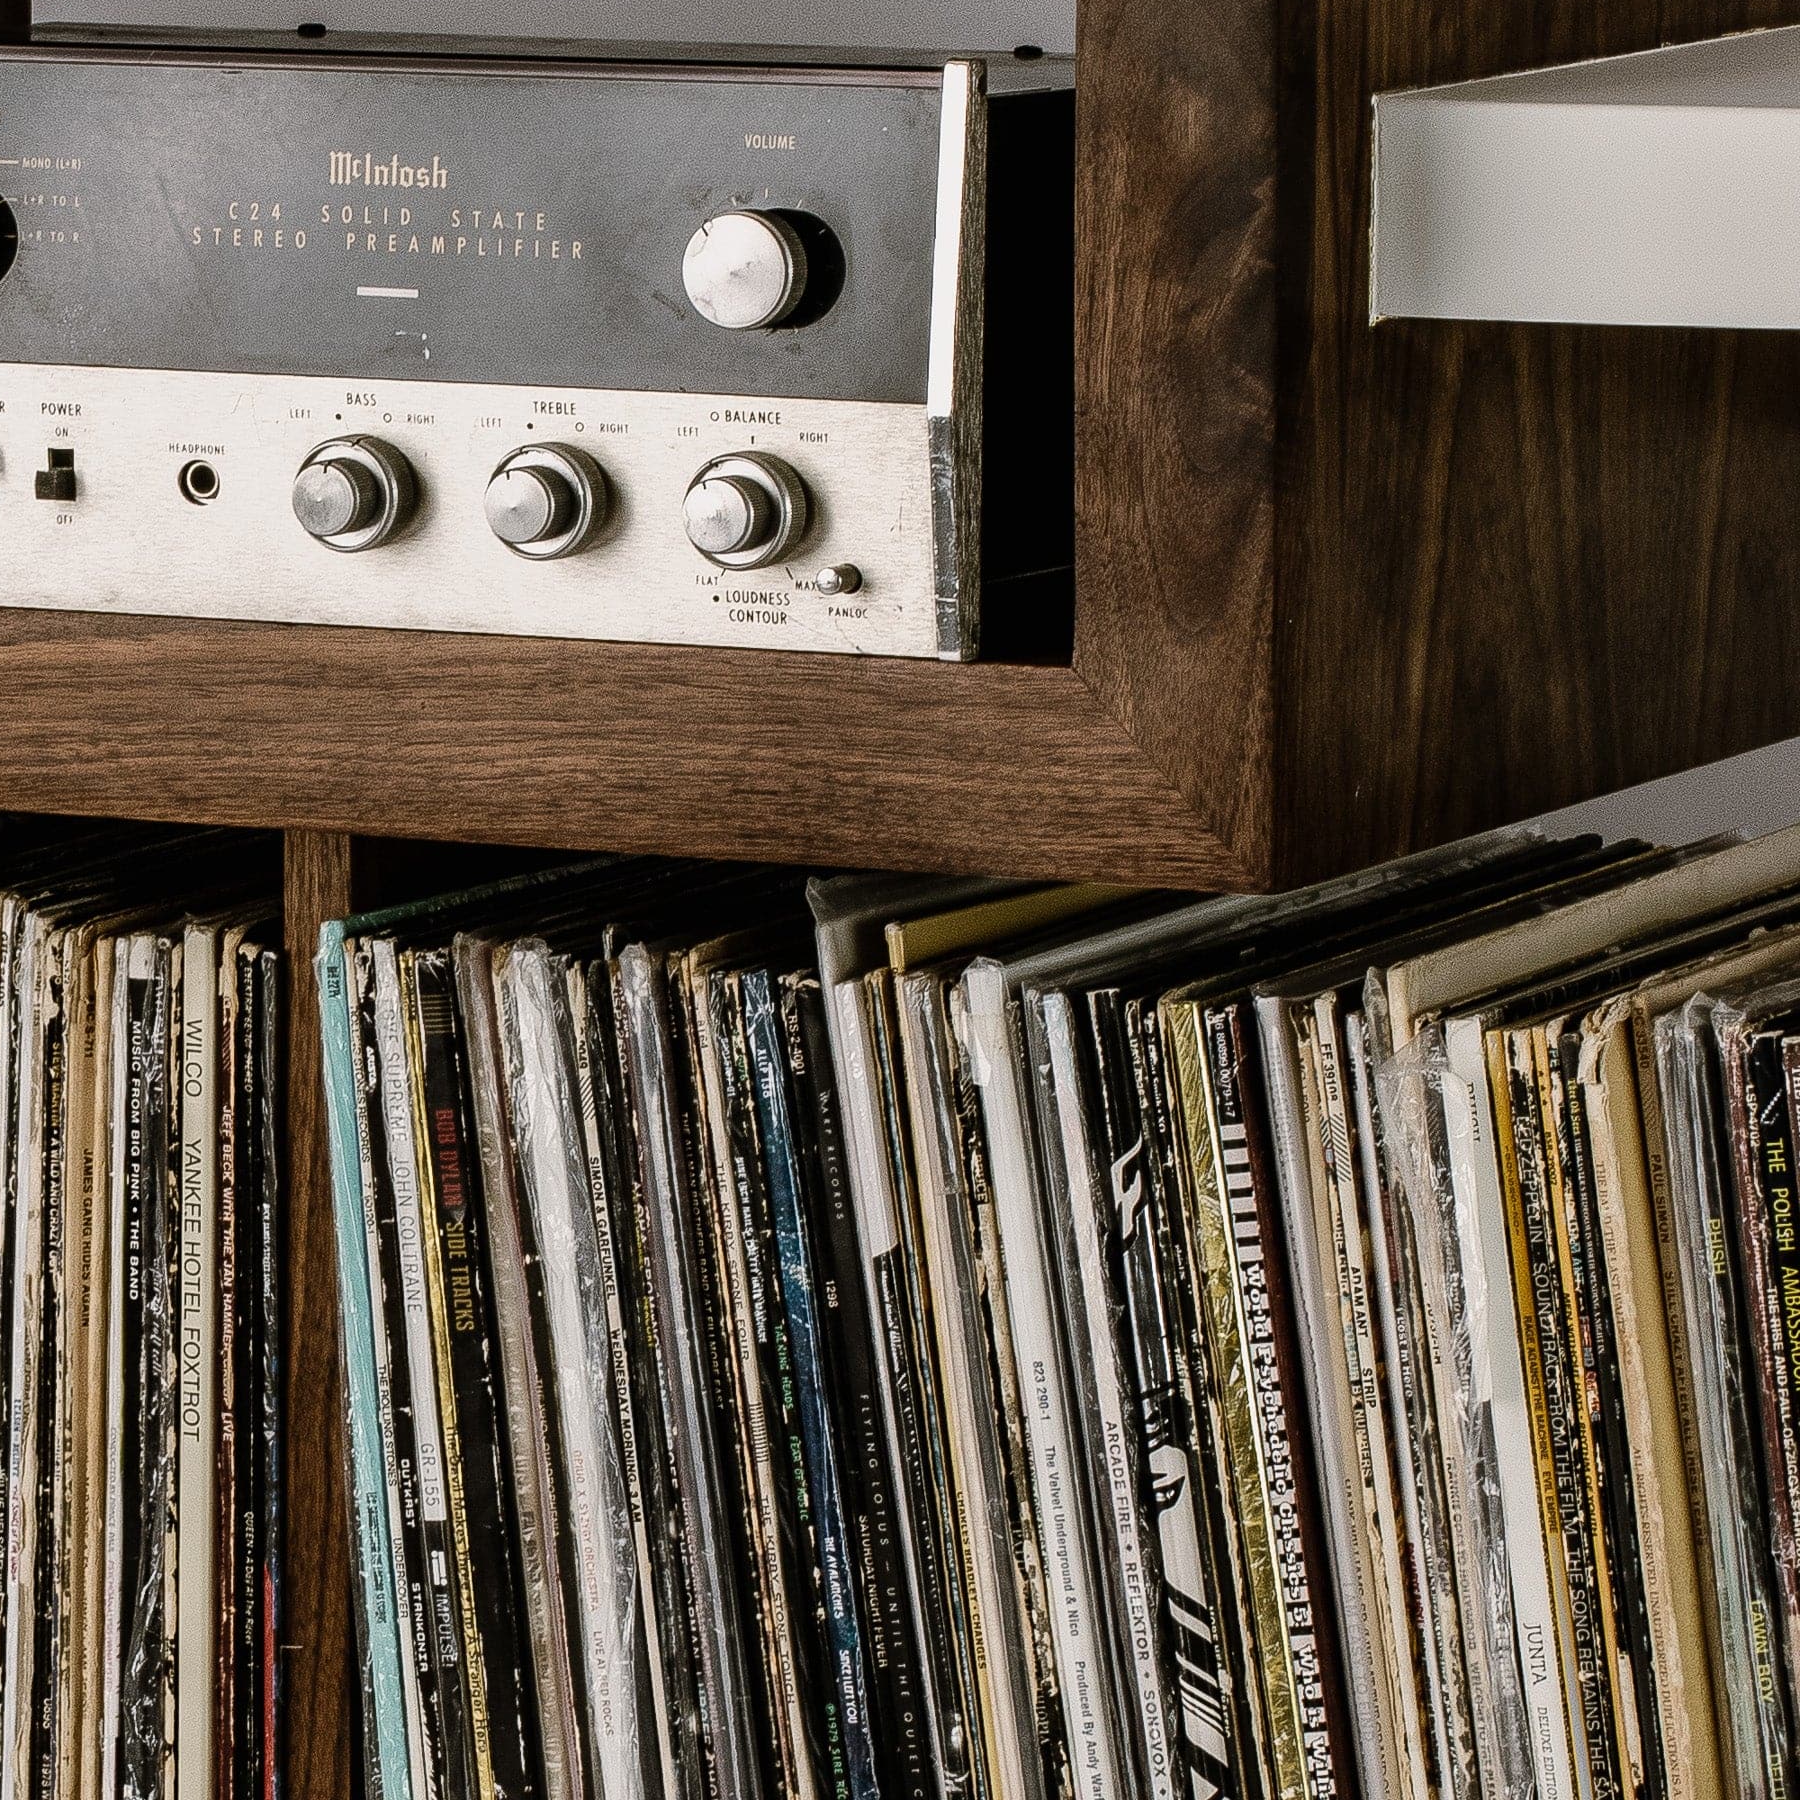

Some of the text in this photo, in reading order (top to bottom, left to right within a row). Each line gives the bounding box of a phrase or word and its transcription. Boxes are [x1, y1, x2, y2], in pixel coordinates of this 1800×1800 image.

[745, 134, 796, 149] VOLUME
[23, 157, 50, 169] MONO
[330, 151, 448, 189] McIntosh
[229, 202, 545, 230] C24 SOLID STATE
[192, 226, 582, 259] STEREO PREAMPLIFIER
[41, 402, 82, 416] POWER
[347, 393, 377, 407] BASS
[533, 401, 576, 416] TREBLE
[290, 408, 311, 419] LEFT
[407, 414, 435, 425] RIGHT
[480, 417, 501, 428] LEFT
[725, 410, 781, 425] BALANCE
[55, 427, 68, 437] ON
[600, 422, 629, 434] RIGHT
[678, 426, 699, 438] LEFT
[800, 432, 829, 444] RIGHT
[169, 442, 225, 455] HEADPHONE
[56, 514, 72, 524] OFF
[696, 575, 719, 586] FLAT
[726, 590, 790, 606] LOUDNESS
[729, 609, 787, 624] CONTOUR
[829, 607, 868, 619] PANLOC
[185, 1020, 202, 1097] WILCO
[129, 1021, 141, 1300] MUSIC FROM BIG PINK THE BAND
[1766, 1138, 1786, 1172] THE
[184, 1140, 201, 1233] YANKEE
[436, 1109, 473, 1331] BOB DYLAN SIDE TRACKS
[1771, 1188, 1794, 1250] POLISH
[184, 1242, 200, 1321] HOTEL
[386, 1052, 440, 1506] SUPREME JOHN COLTRANE GR-155
[1247, 1264, 1270, 1337] World
[182, 1328, 200, 1441] FOXTROT
[1258, 1348, 1289, 1493] Psychedelic
[1276, 1503, 1300, 1601] Classics
[400, 1458, 430, 1672] OUTKAST STANKONIA
[1104, 1421, 1127, 1489] ARCADE
[1116, 1496, 1132, 1533] FIRE
[1124, 1562, 1150, 1661] REFLEKTOR
[1143, 1690, 1167, 1777] SONOVOX
[435, 1593, 454, 1668] IMPULSE!
[1298, 1645, 1320, 1699] Who
[1523, 1623, 1547, 1685] JUNTA
[1537, 1707, 1553, 1753] DELUXE
[1306, 1707, 1323, 1726] is
